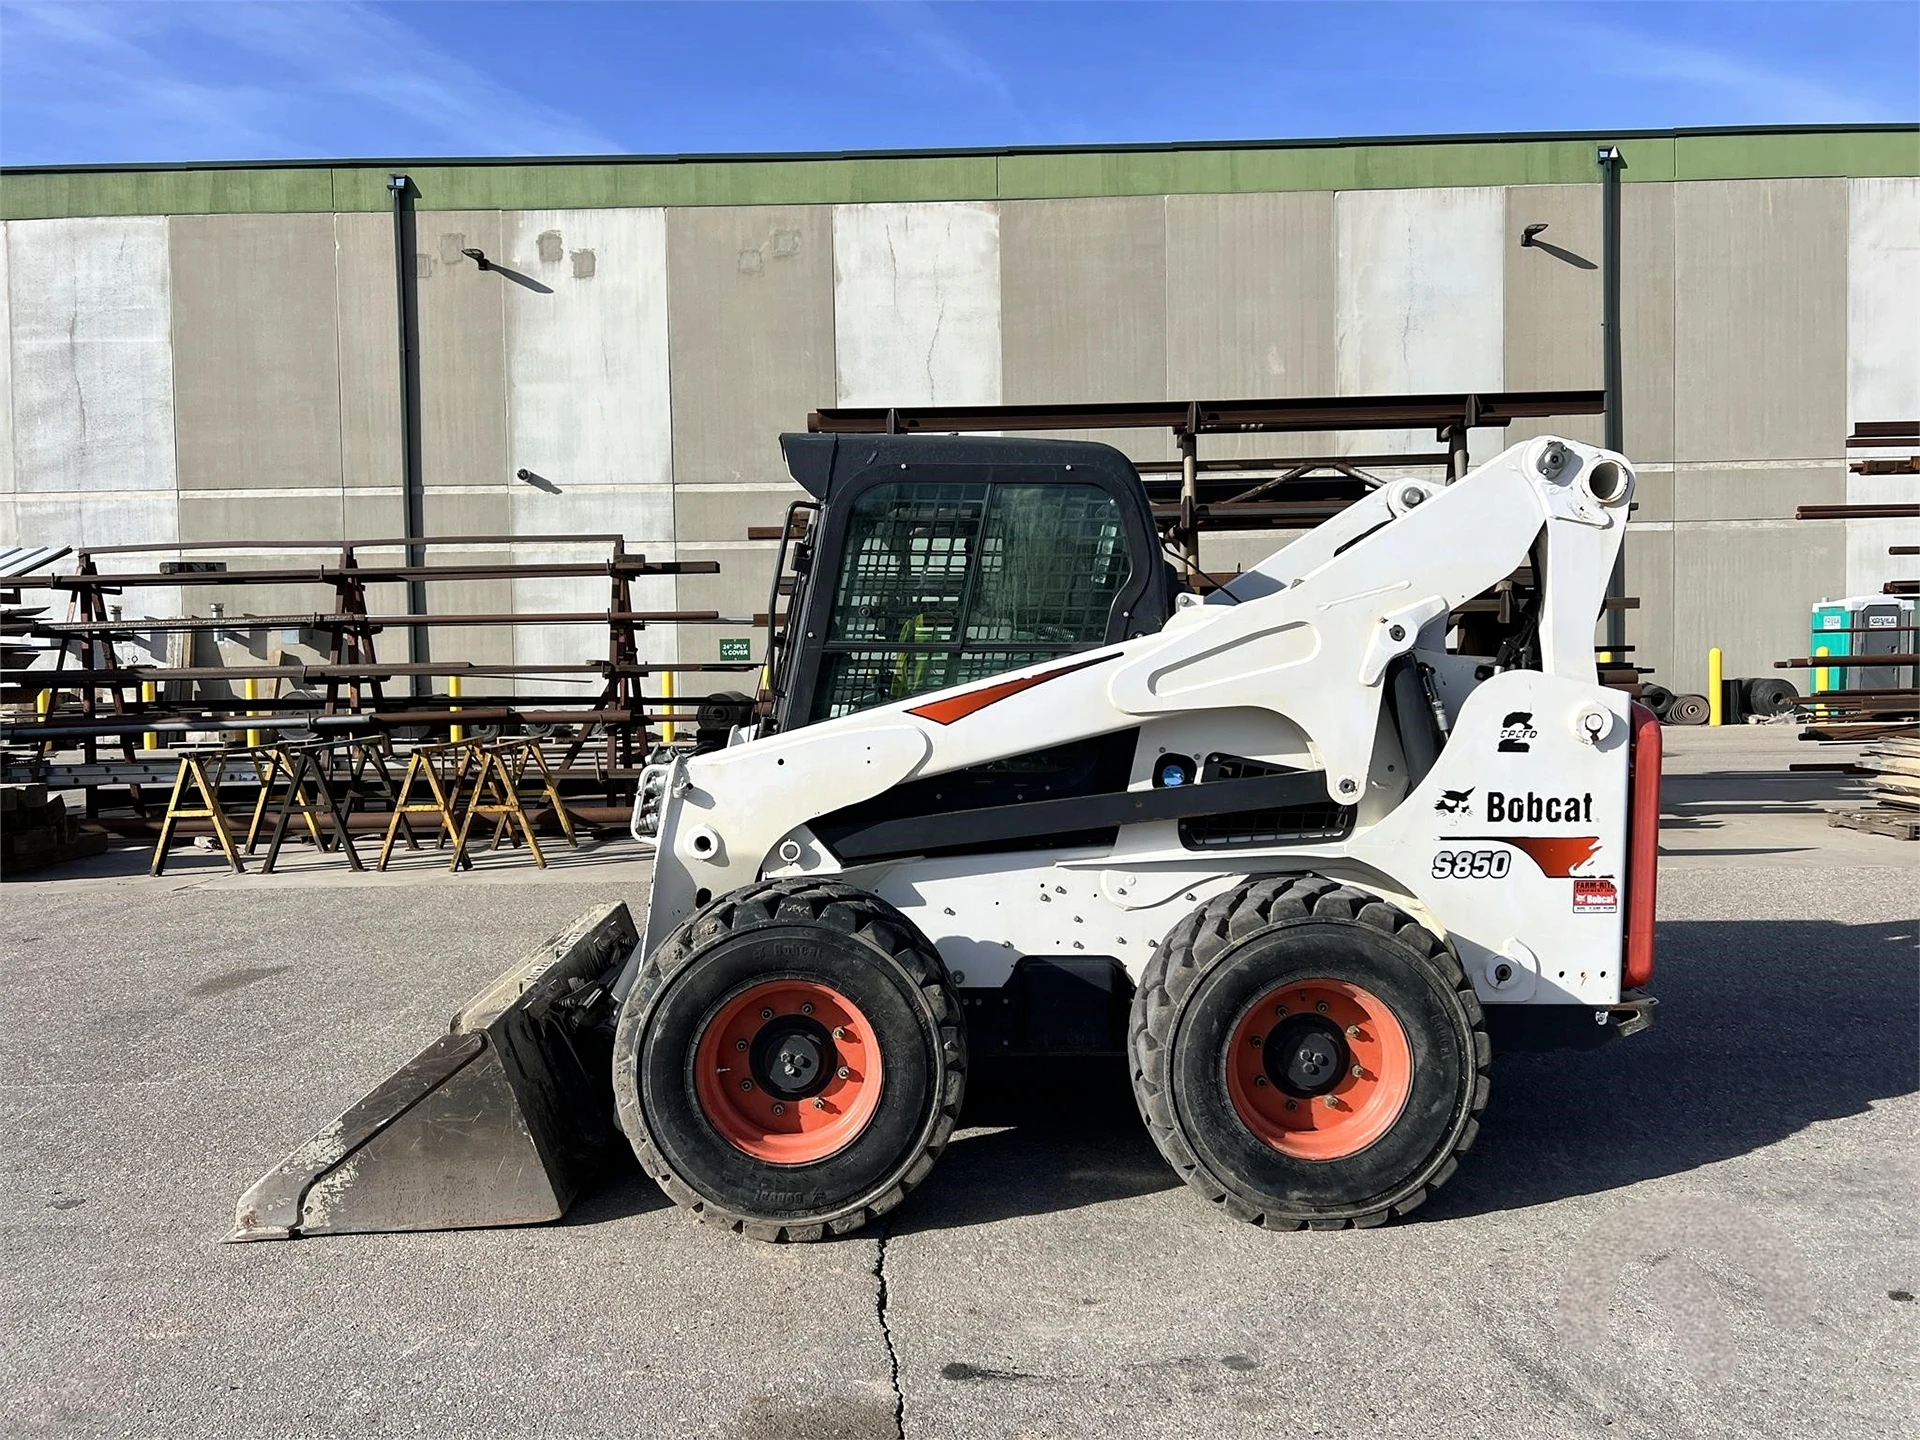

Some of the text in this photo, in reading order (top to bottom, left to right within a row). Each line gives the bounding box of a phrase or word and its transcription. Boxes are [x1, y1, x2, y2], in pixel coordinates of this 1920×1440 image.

[1487, 791, 1593, 823] Bobcat
[1431, 850, 1512, 879] S850
[1586, 894, 1614, 904] Bobcat
